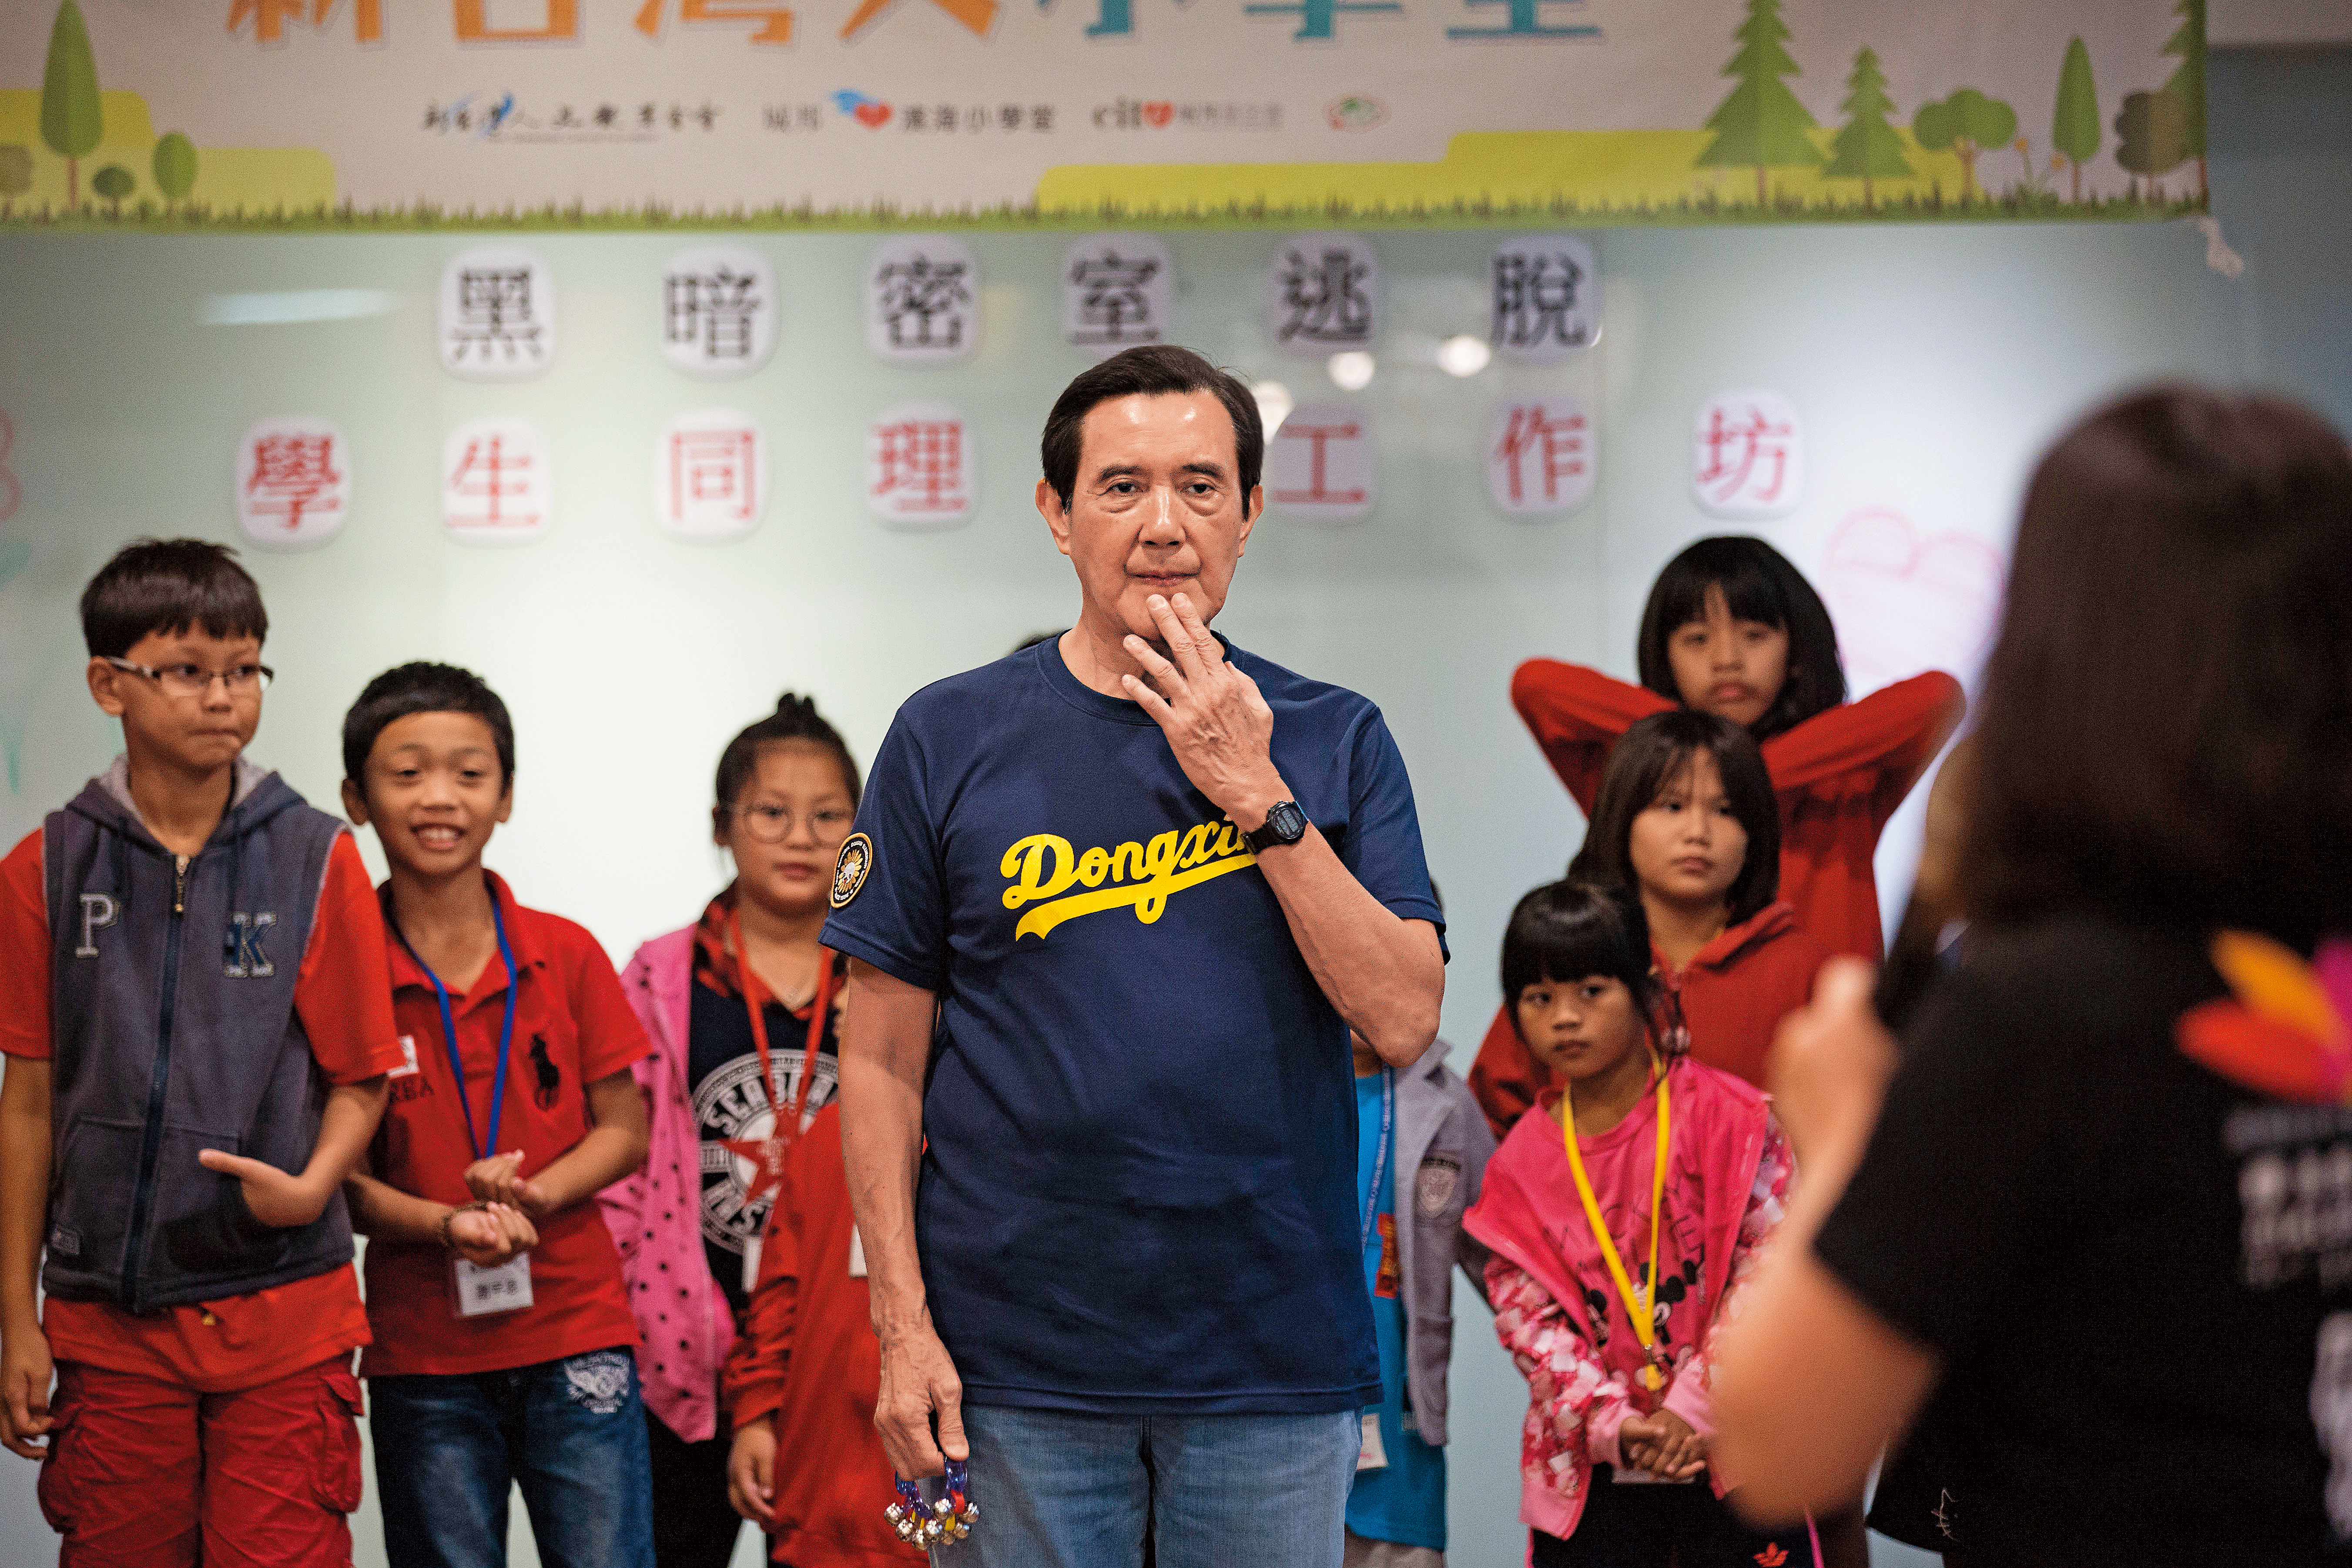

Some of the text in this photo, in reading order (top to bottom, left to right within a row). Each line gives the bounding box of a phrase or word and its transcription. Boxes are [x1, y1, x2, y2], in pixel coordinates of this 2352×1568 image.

[451, 251, 1589, 362] 黑暗密室逃脫
[1000, 816, 1245, 925] Dongxi
[75, 893, 277, 978] P K
